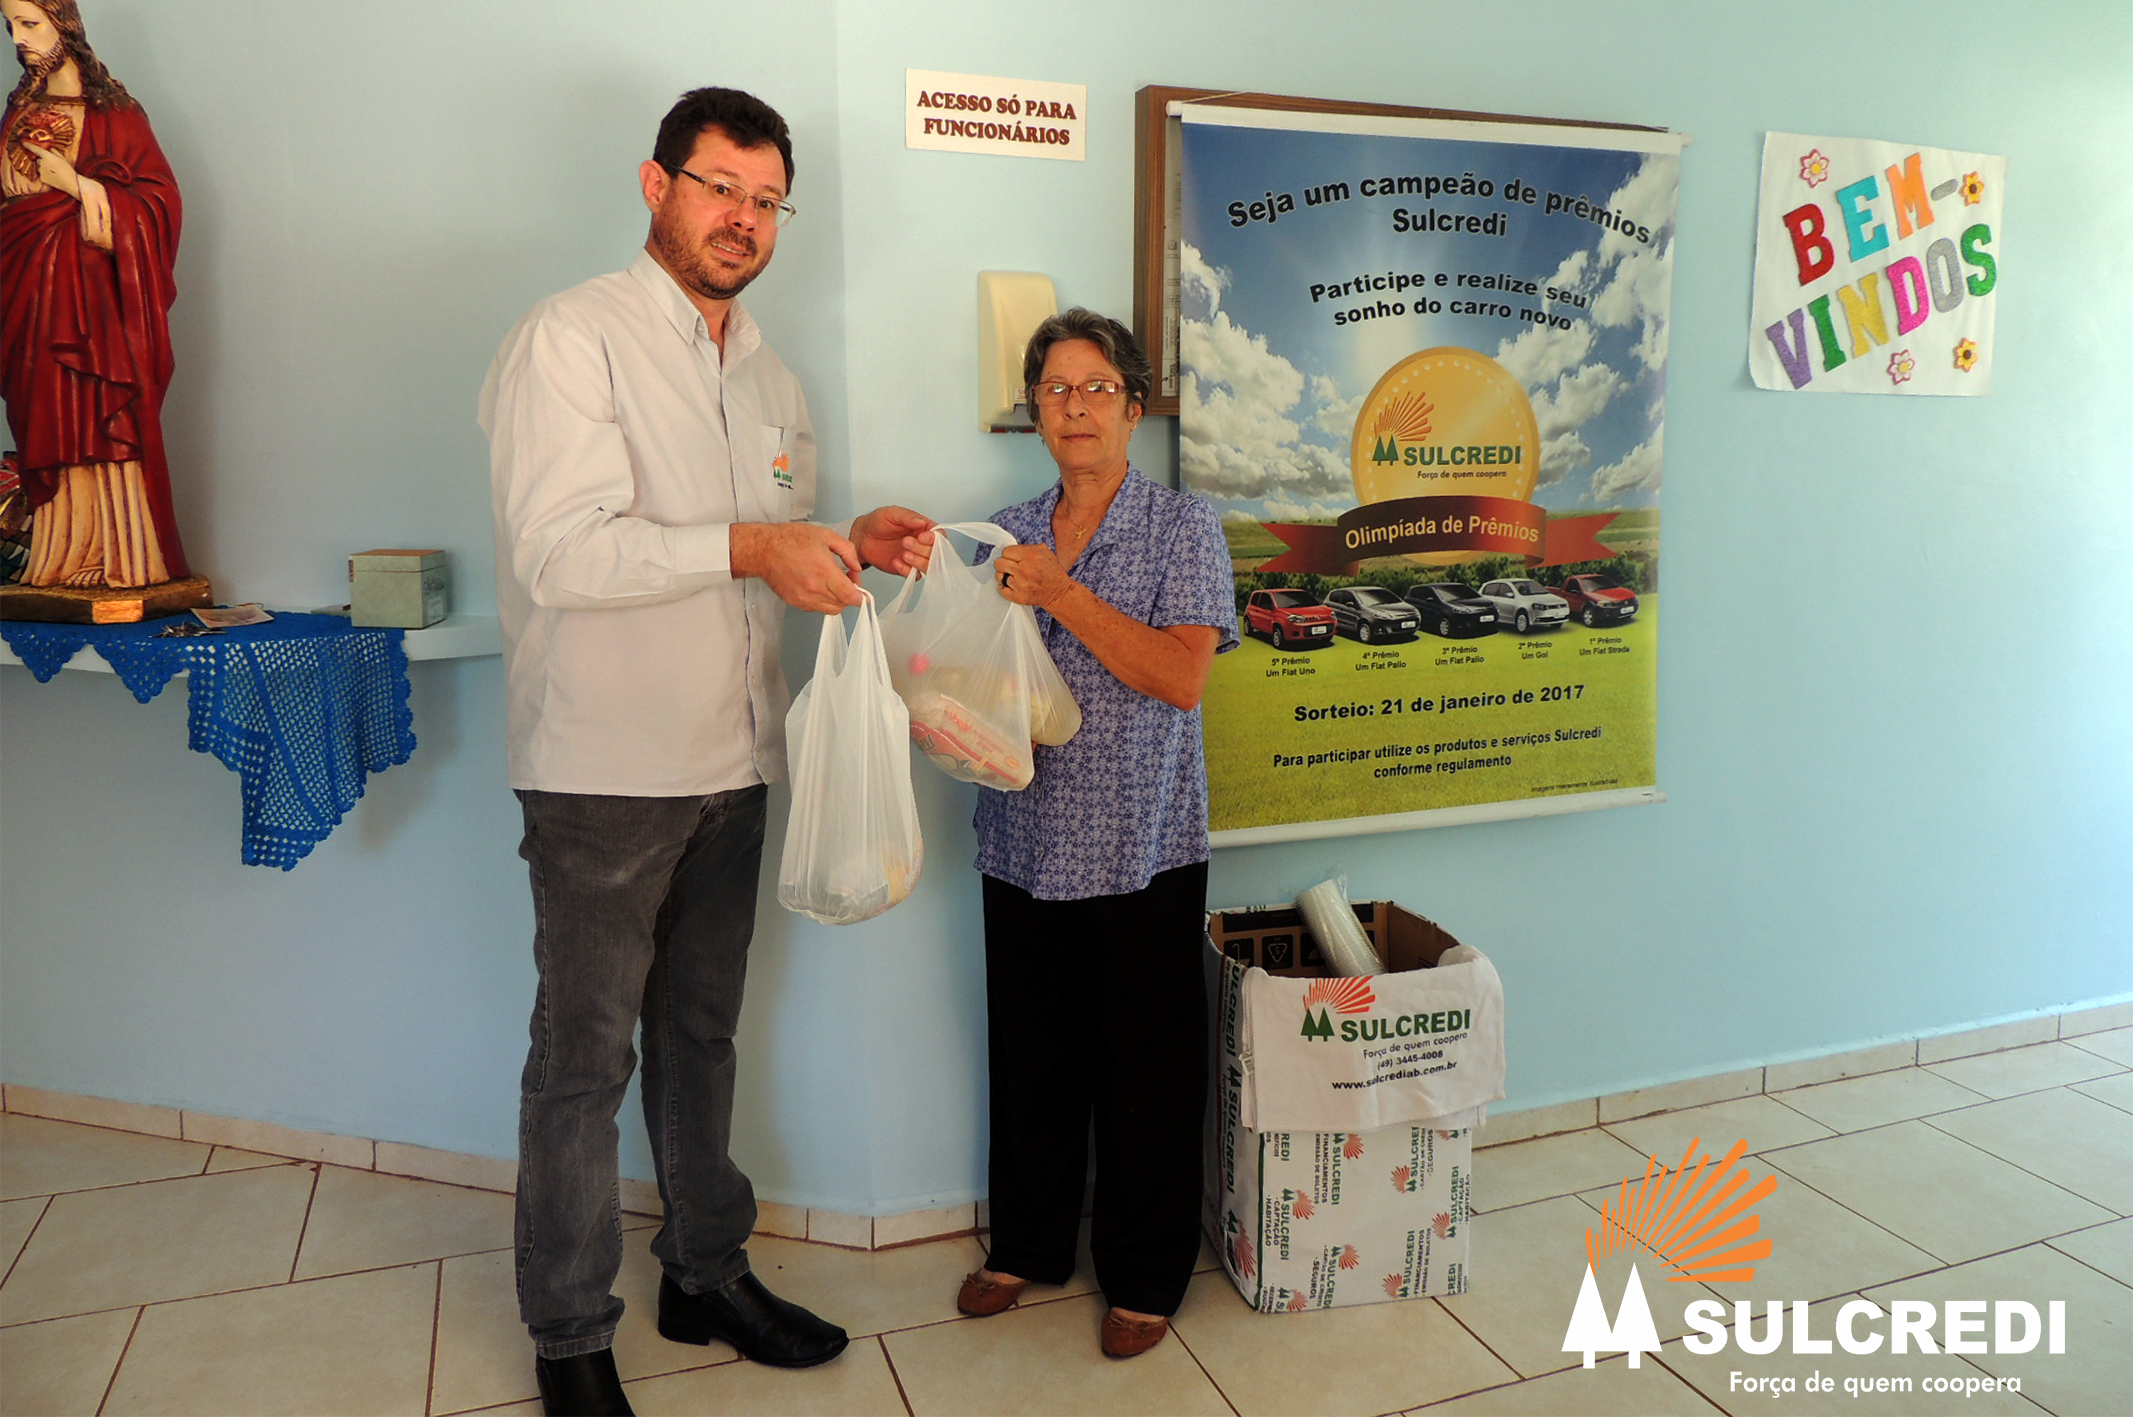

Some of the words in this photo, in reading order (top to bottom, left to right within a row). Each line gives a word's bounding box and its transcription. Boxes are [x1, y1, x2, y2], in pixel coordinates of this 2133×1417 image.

[917, 91, 992, 113] ACESSO
[996, 94, 1021, 115] SÓ
[1025, 100, 1077, 120] PARA
[924, 118, 1070, 145] FUNCIONÁRIOS
[1228, 191, 1295, 227] Seja
[1304, 182, 1350, 206] um
[1360, 172, 1494, 200] campeão
[1504, 179, 1537, 204] de
[1545, 191, 1650, 244] prêmios
[1393, 208, 1507, 236] Sulcredi
[1783, 152, 1959, 287] BEM-
[1310, 272, 1425, 302] Participe
[1434, 273, 1448, 286] e
[1457, 274, 1537, 295] realize
[1545, 286, 1586, 308] seu
[1334, 301, 1406, 325] sonho
[1414, 297, 1442, 314] do
[1450, 300, 1511, 318] carro
[1520, 308, 1571, 330] novo
[1766, 223, 1997, 390] VINDOS
[1403, 446, 1521, 466] SULCREDI
[1417, 471, 1438, 481] Força
[1440, 470, 1450, 478] de
[1452, 471, 1474, 480] quem
[1476, 470, 1507, 480] coopera
[1346, 517, 1436, 549] Olimpíada
[1442, 515, 1463, 533] de
[1469, 515, 1539, 543] Prêmios
[1372, 651, 1399, 659] Prêmio
[1451, 646, 1478, 654] Prêmio
[1527, 641, 1552, 649] Prêmio
[1597, 637, 1622, 645] Prêmio
[1608, 646, 1630, 654] Strada
[1282, 657, 1310, 665] Prêmio
[1355, 663, 1368, 671] Um
[1371, 662, 1386, 670] Fiat
[1387, 660, 1406, 668] Palio
[1435, 658, 1448, 666] Um
[1465, 656, 1485, 664] Palio
[1522, 652, 1534, 660] Um
[1536, 651, 1548, 659] Gol
[1299, 668, 1315, 676] Uno
[1294, 702, 1374, 722] Sorteio:
[1381, 699, 1402, 715] 21
[1411, 697, 1434, 712] de
[1439, 692, 1506, 714] janeiro
[1512, 690, 1534, 704] de
[1540, 685, 1585, 701] 2017
[1274, 754, 1303, 767] Para
[1308, 749, 1371, 768] participar
[1374, 744, 1412, 758] utilize
[1416, 744, 1430, 754] os
[1434, 739, 1487, 755] produtos
[1491, 738, 1498, 747] e
[1501, 732, 1551, 747] serviços
[1554, 726, 1602, 742] Sulcredi
[1374, 763, 1432, 778] conforme
[1437, 755, 1512, 774] regulamento
[1341, 1009, 1471, 1042] SULCREDI
[1364, 1047, 1387, 1060] Força
[1389, 1043, 1401, 1053] de
[1404, 1039, 1431, 1051] quem
[1434, 1032, 1468, 1045] coopera
[1377, 1059, 1393, 1071] (49)
[1396, 1050, 1443, 1066] 3445-4008
[1332, 1061, 1457, 1090] www.sulcrediab.com.br
[1226, 1089, 1238, 1194] SULCREDI
[1331, 1146, 1342, 1205] SULCREDI
[1450, 1165, 1459, 1224] SULCREDI
[1281, 1203, 1290, 1260] SULCREDI
[1403, 1230, 1415, 1284] SULCREDI
